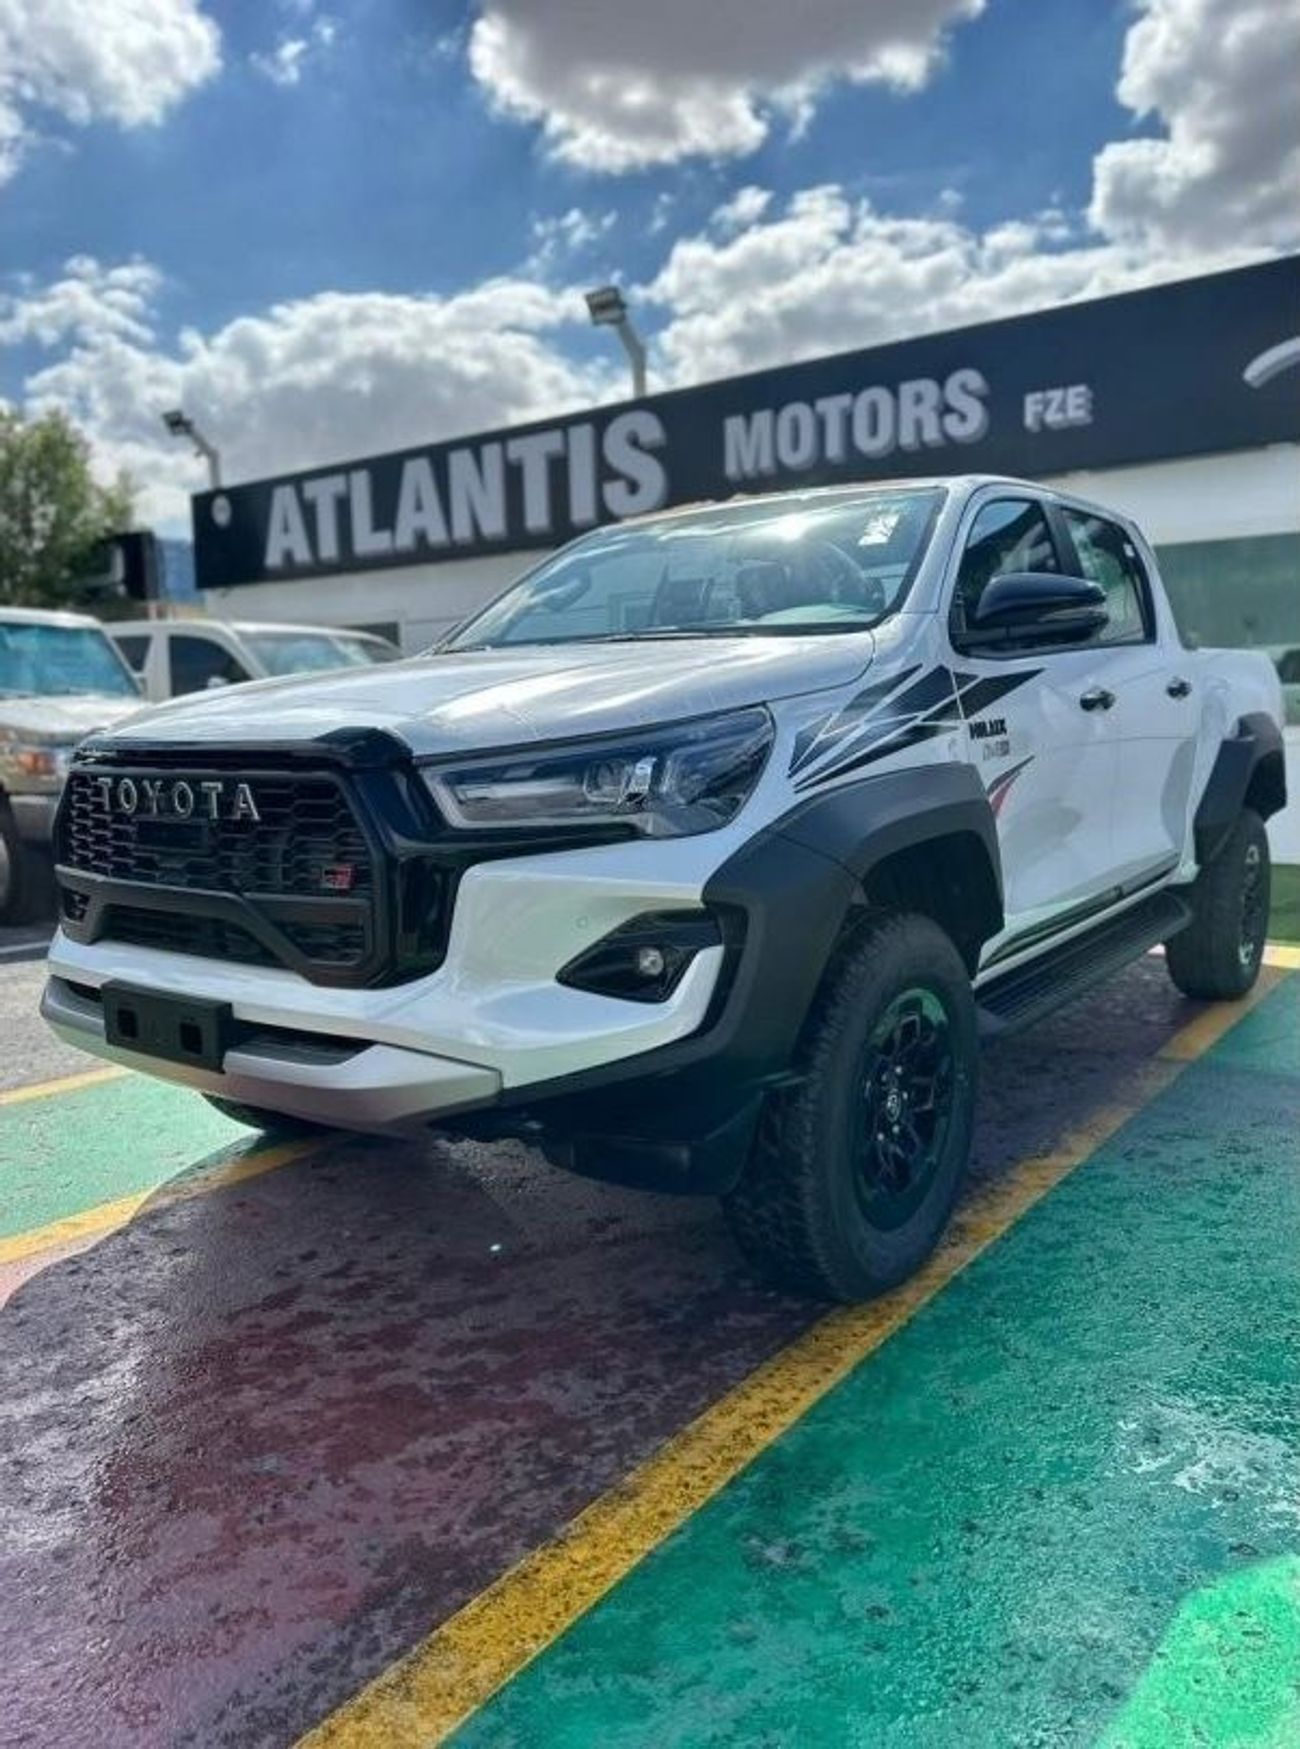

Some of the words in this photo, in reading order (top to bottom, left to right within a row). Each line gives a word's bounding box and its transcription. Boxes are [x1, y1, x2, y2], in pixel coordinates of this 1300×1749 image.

[264, 410, 668, 570] ATLANTIS
[724, 369, 988, 480] MOTORS
[1023, 384, 1092, 432] FZE
[98, 777, 260, 821] TOYOTA
